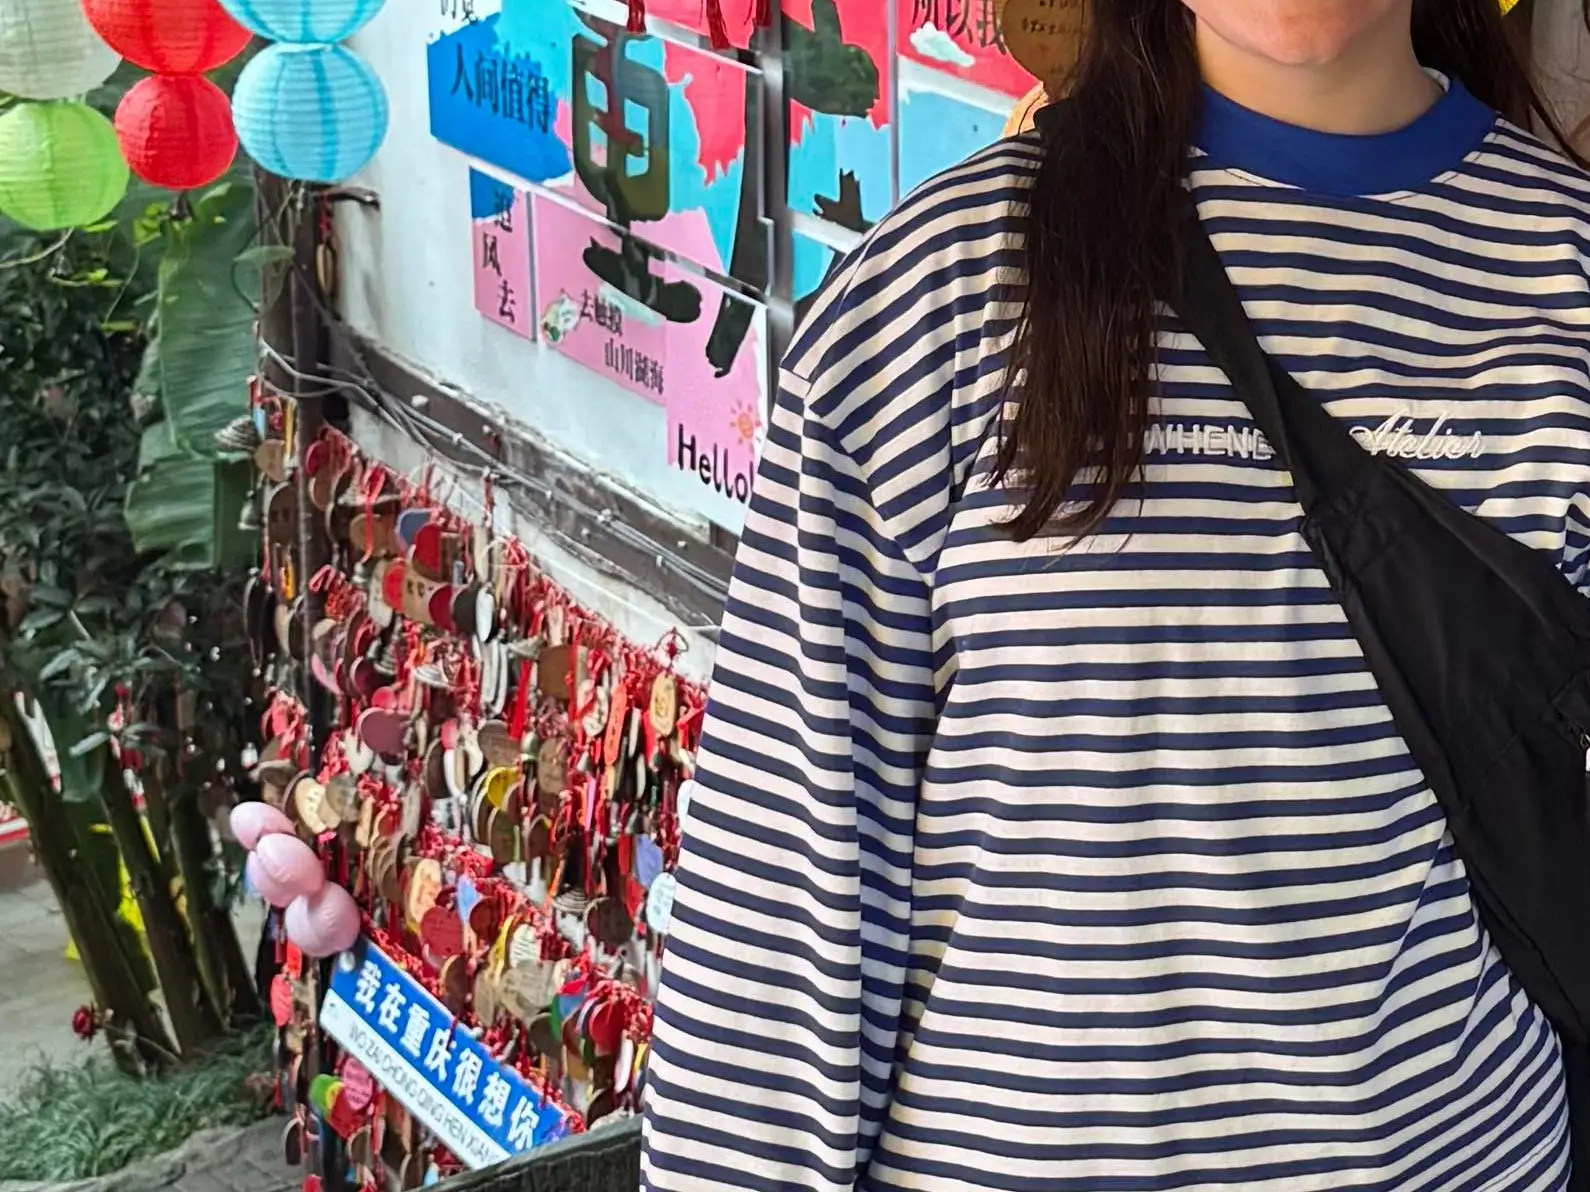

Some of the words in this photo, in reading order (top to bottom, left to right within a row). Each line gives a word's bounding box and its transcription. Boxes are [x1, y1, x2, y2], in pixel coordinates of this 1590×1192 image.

[450, 40, 551, 135] 人间值得
[1348, 407, 1486, 460] Atelier
[354, 959, 539, 1150] 我在重庆很想你
